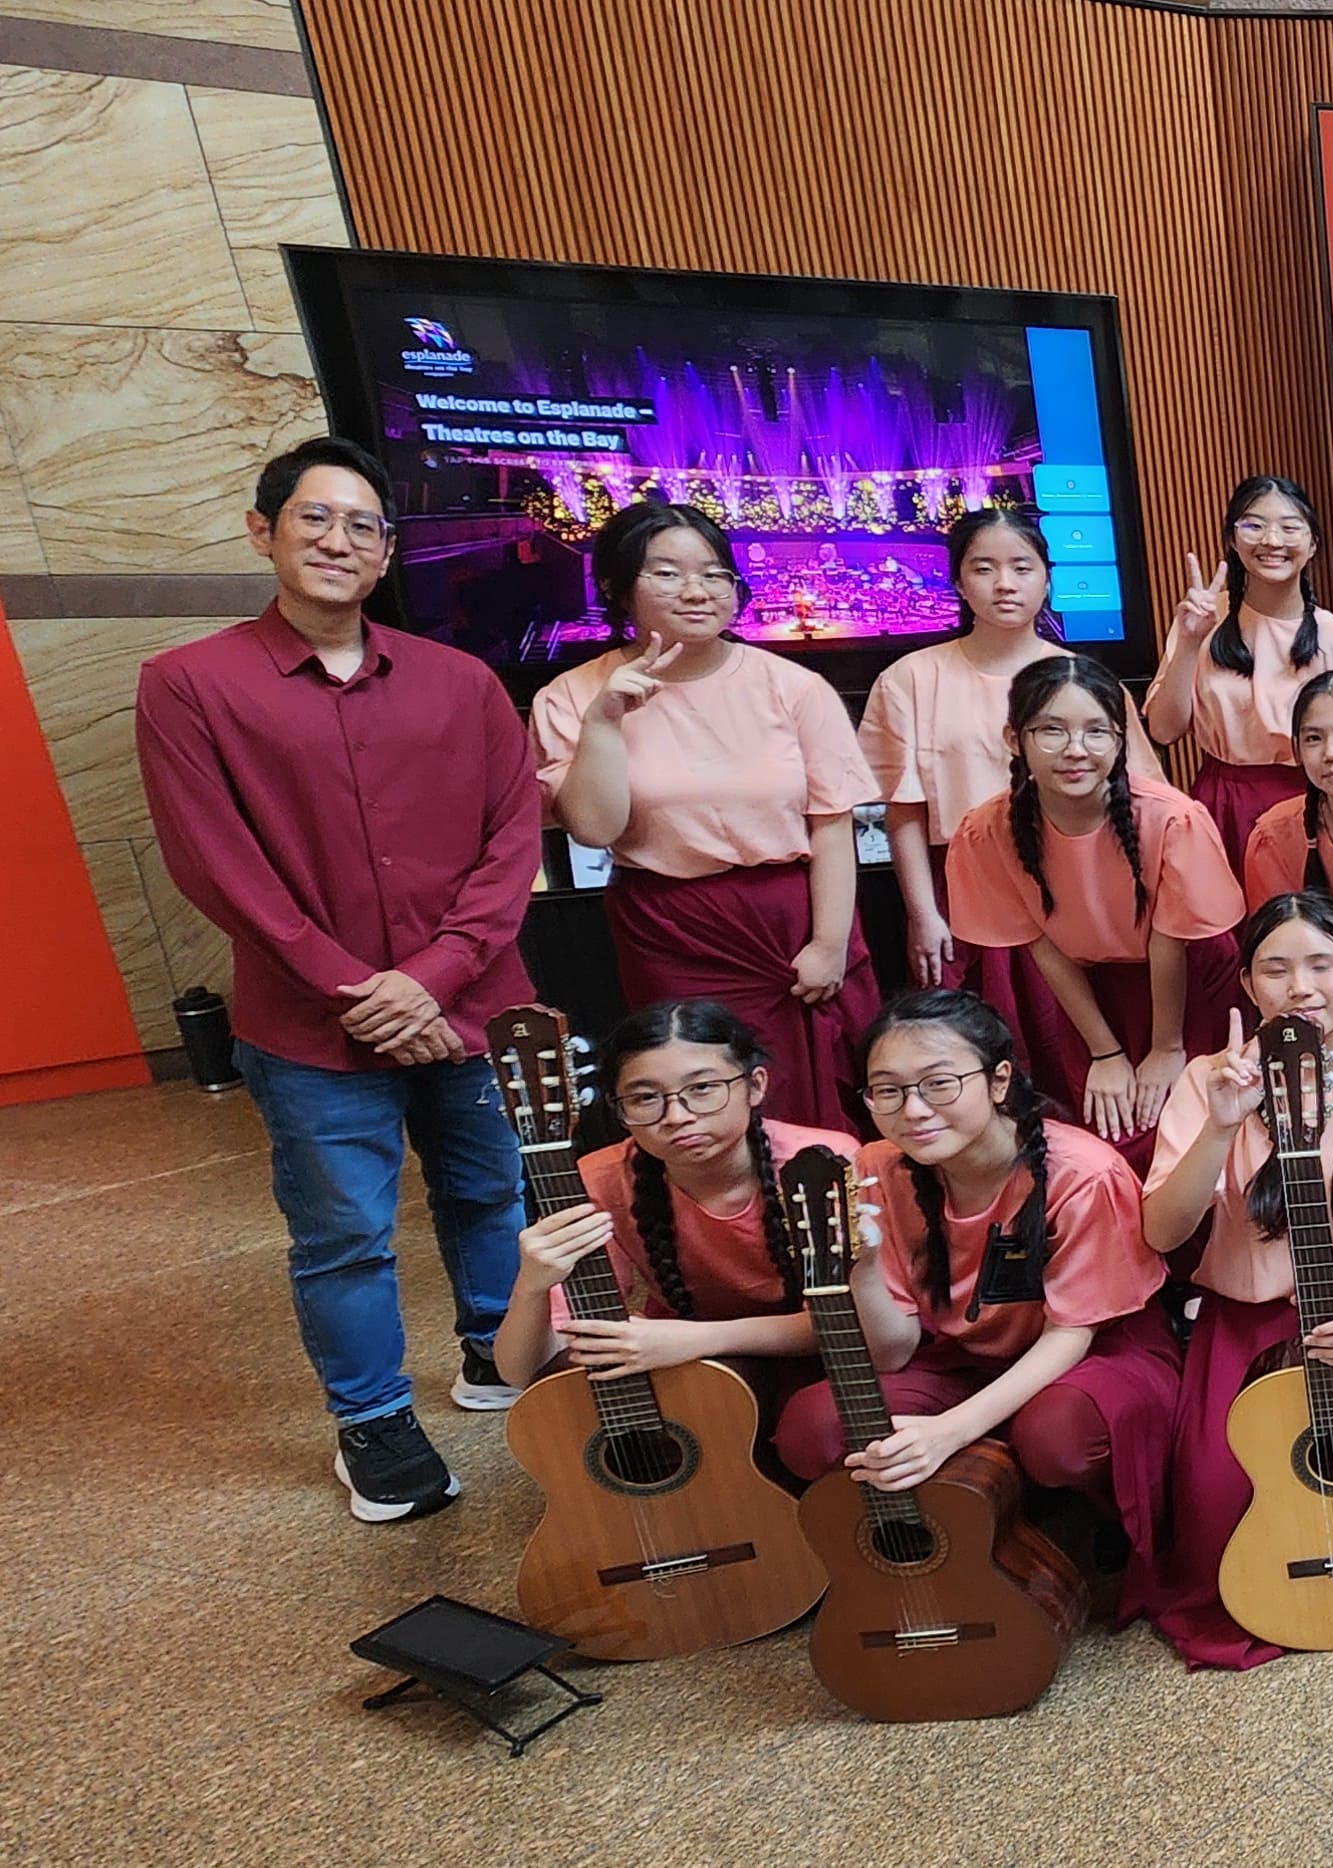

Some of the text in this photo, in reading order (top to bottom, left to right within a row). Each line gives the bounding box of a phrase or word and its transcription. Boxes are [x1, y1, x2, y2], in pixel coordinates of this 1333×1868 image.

[401, 348, 471, 363] esplanade
[416, 394, 511, 414] Welcome
[513, 398, 534, 414] to
[537, 399, 636, 420] Esplanade
[421, 424, 620, 450] Theatres on the Bay
